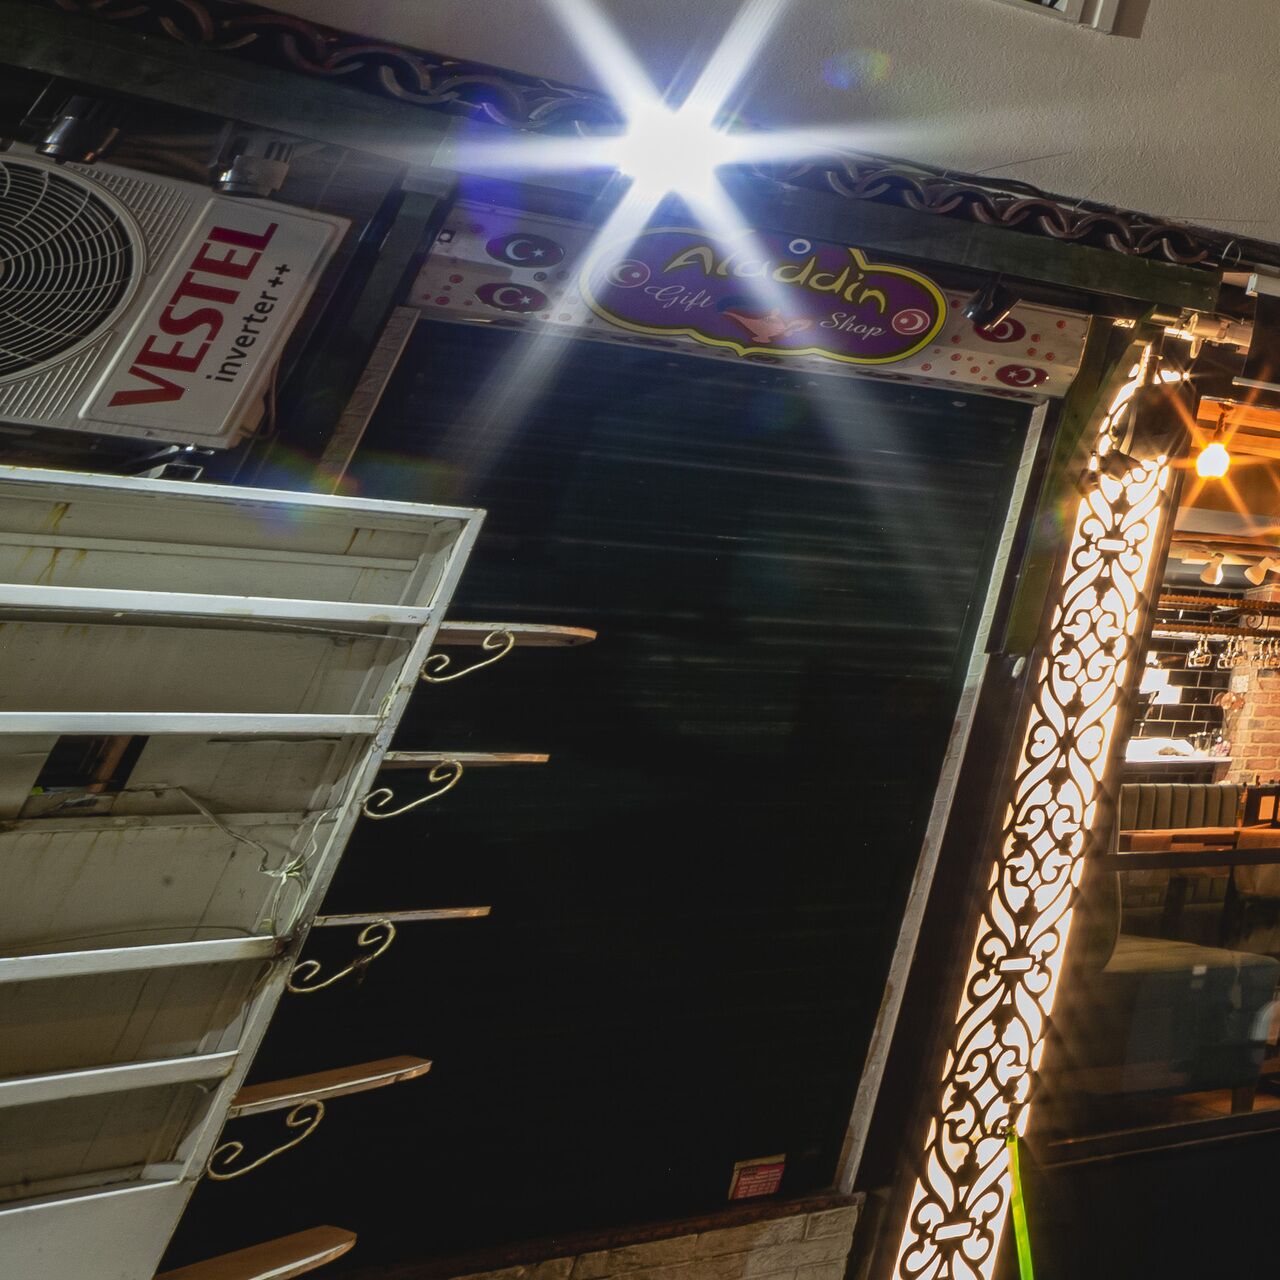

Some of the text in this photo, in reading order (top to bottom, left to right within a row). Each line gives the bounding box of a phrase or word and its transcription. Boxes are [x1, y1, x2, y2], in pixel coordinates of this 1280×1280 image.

[644, 285, 887, 340] Gift Shop
[663, 246, 886, 313] Aladdin
[107, 223, 279, 408] VESTEL
